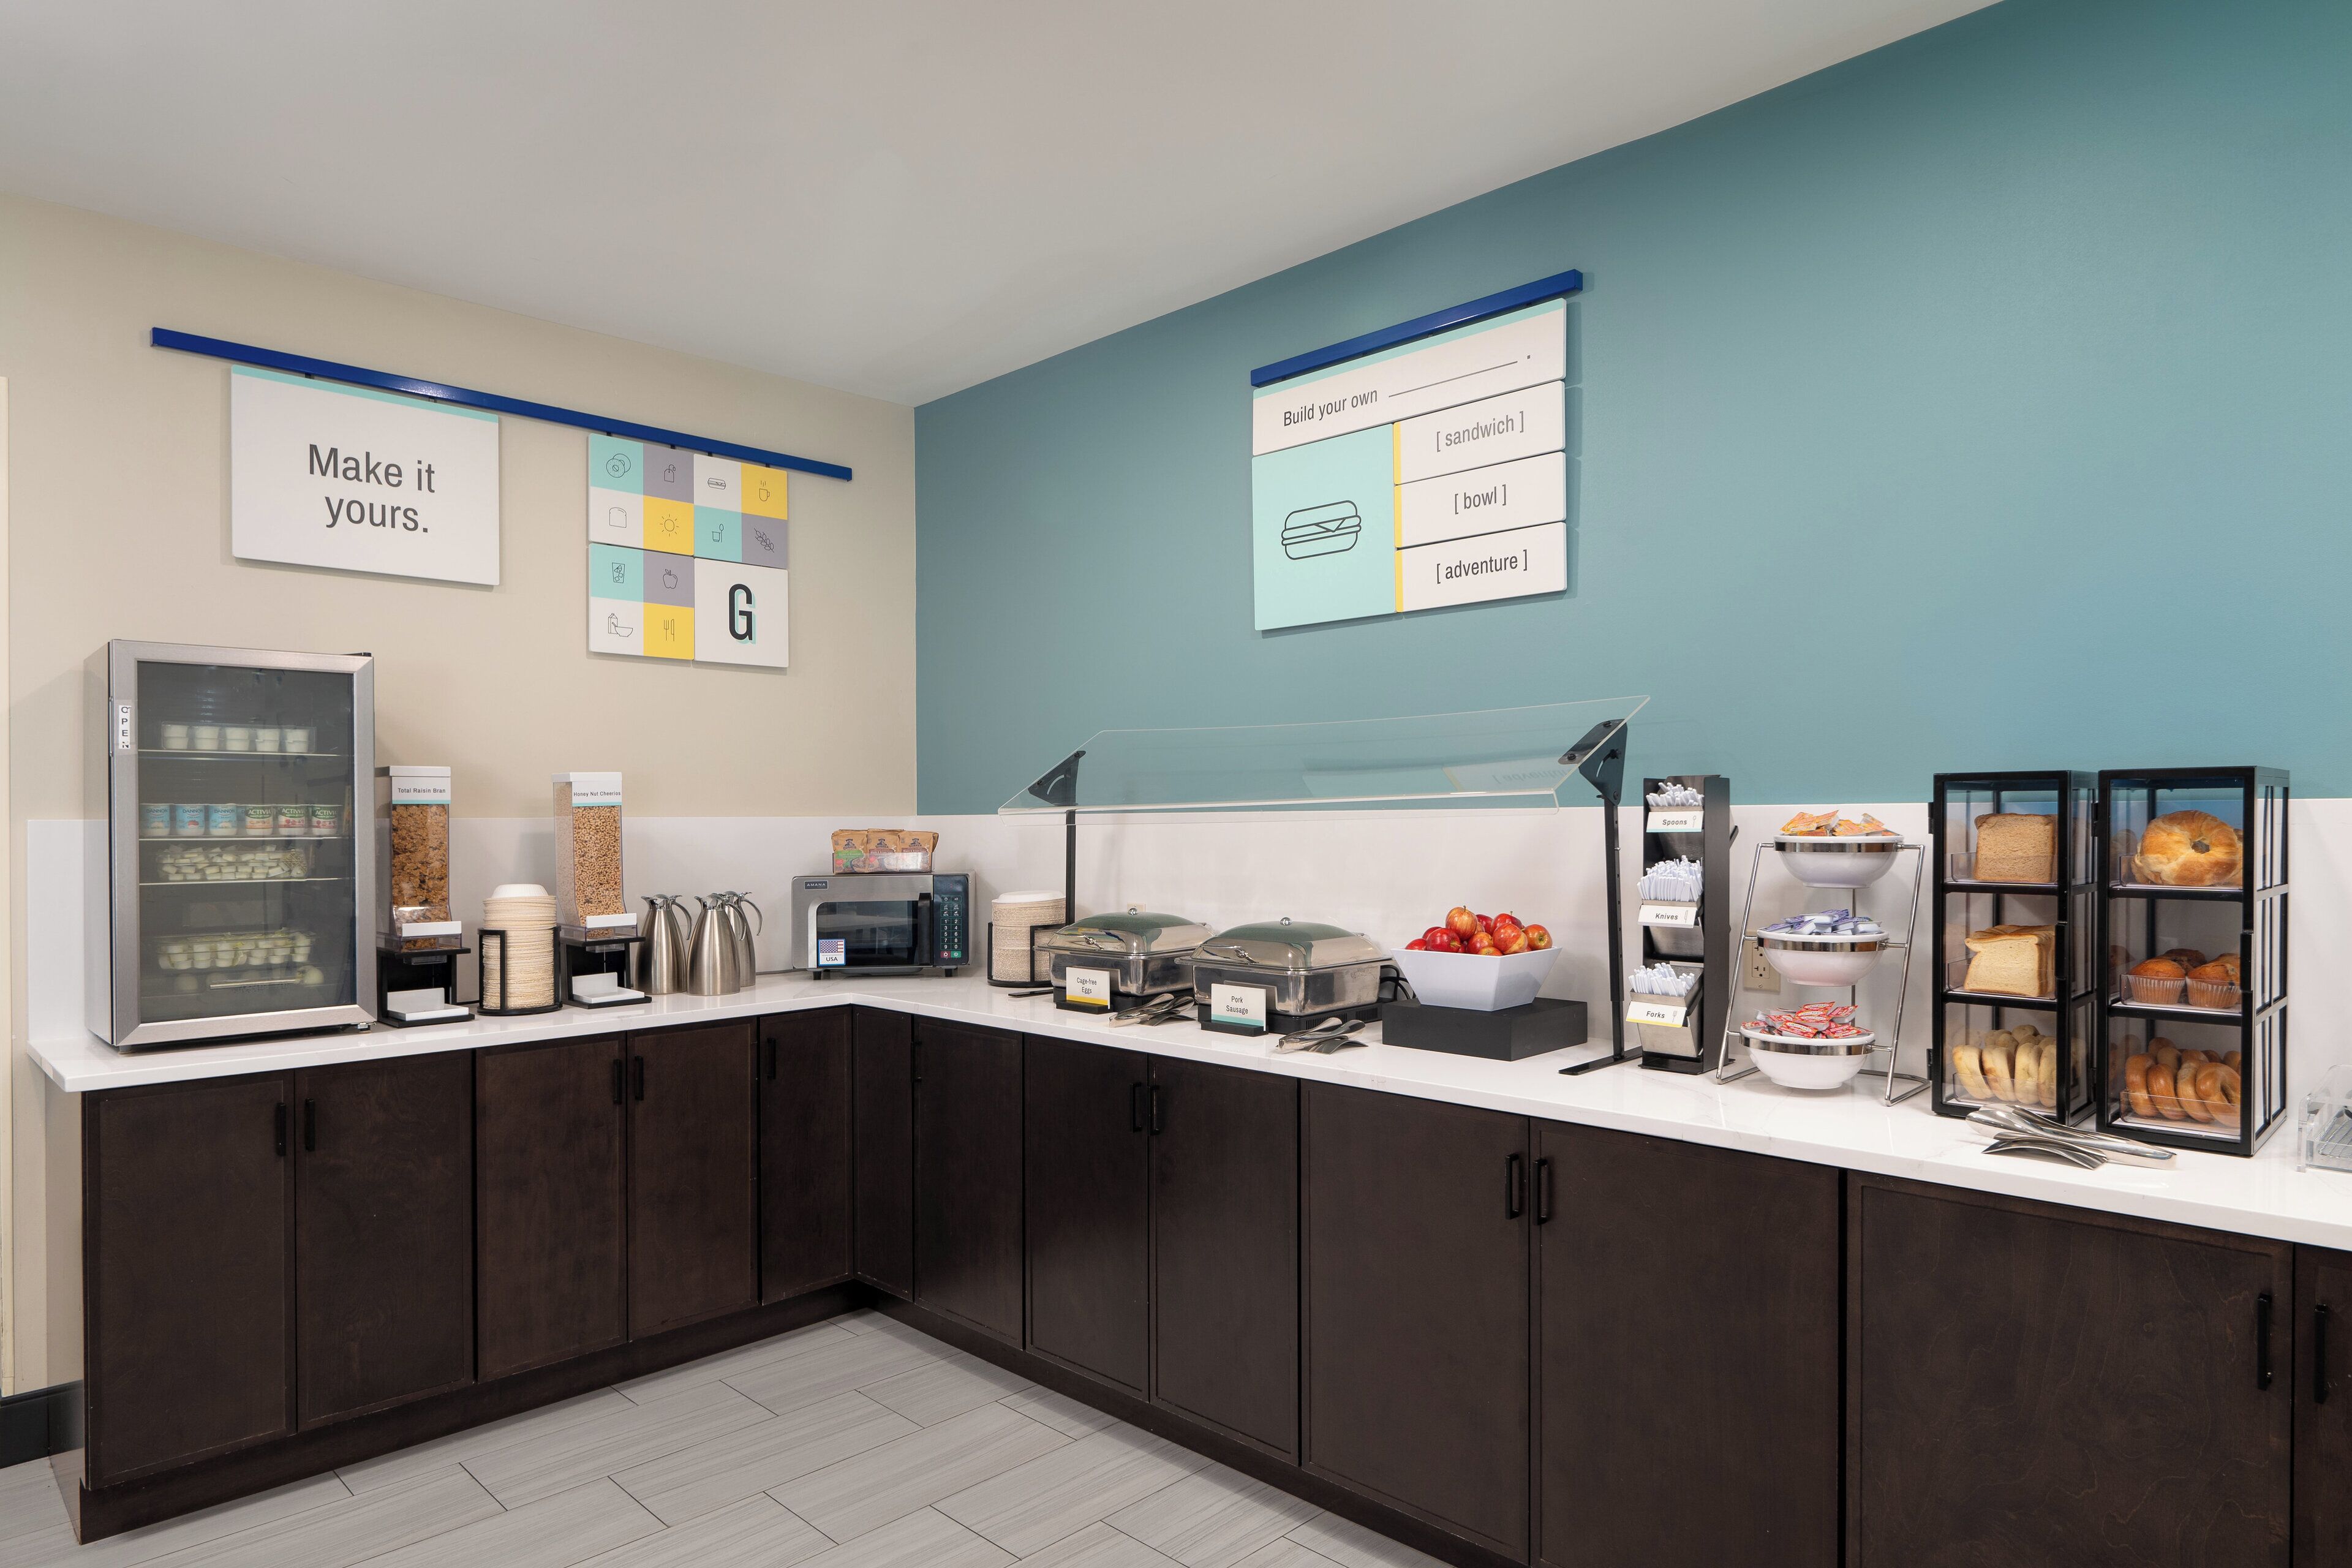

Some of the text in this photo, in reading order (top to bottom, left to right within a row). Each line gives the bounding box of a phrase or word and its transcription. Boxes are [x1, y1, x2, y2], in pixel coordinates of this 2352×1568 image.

[1284, 390, 1378, 426] Build your own
[309, 443, 435, 493] Make it
[325, 496, 428, 532] yours.
[729, 584, 756, 644] G
[121, 706, 130, 748] OPEN
[1226, 1005, 1248, 1015] Sausage
